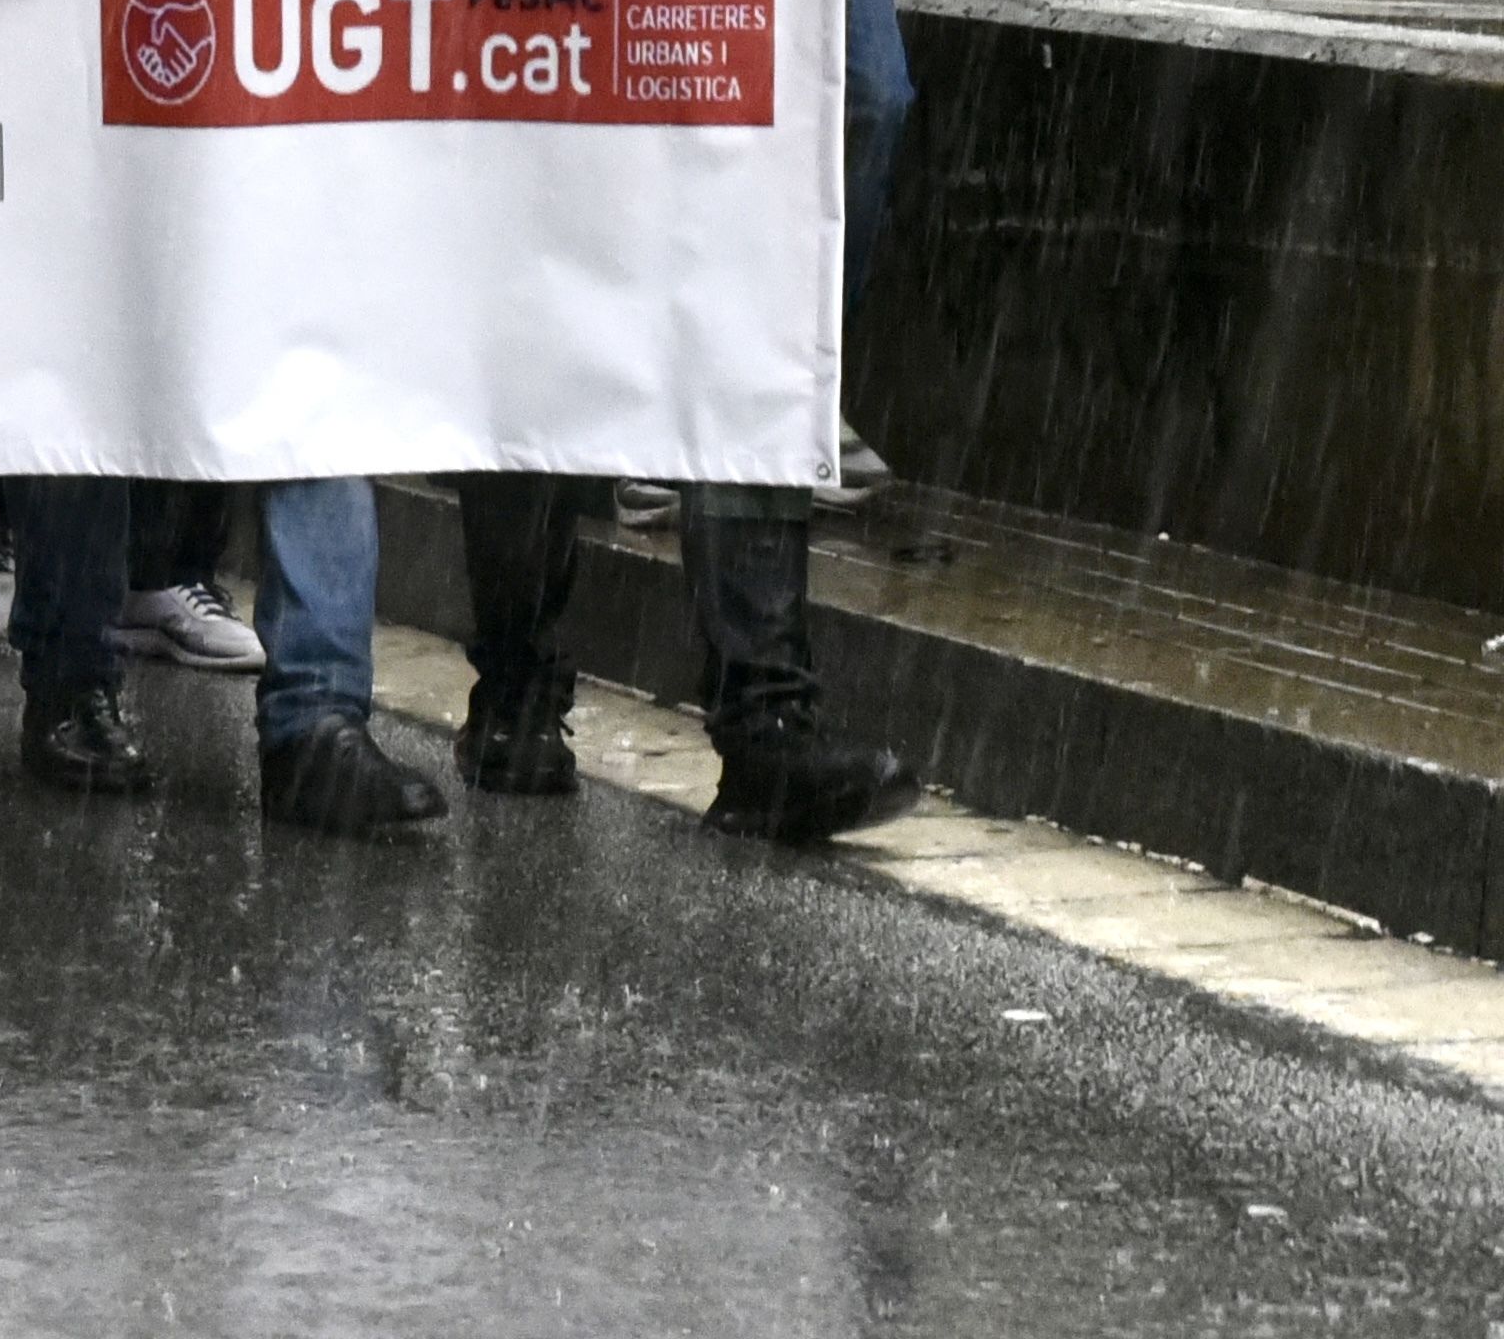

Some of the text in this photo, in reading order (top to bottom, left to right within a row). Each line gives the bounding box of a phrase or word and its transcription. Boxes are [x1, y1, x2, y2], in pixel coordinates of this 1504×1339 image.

[626, 3, 767, 31] CARRETERES
[627, 40, 728, 66] URBANS I
[626, 75, 742, 101] LOGISTICA
